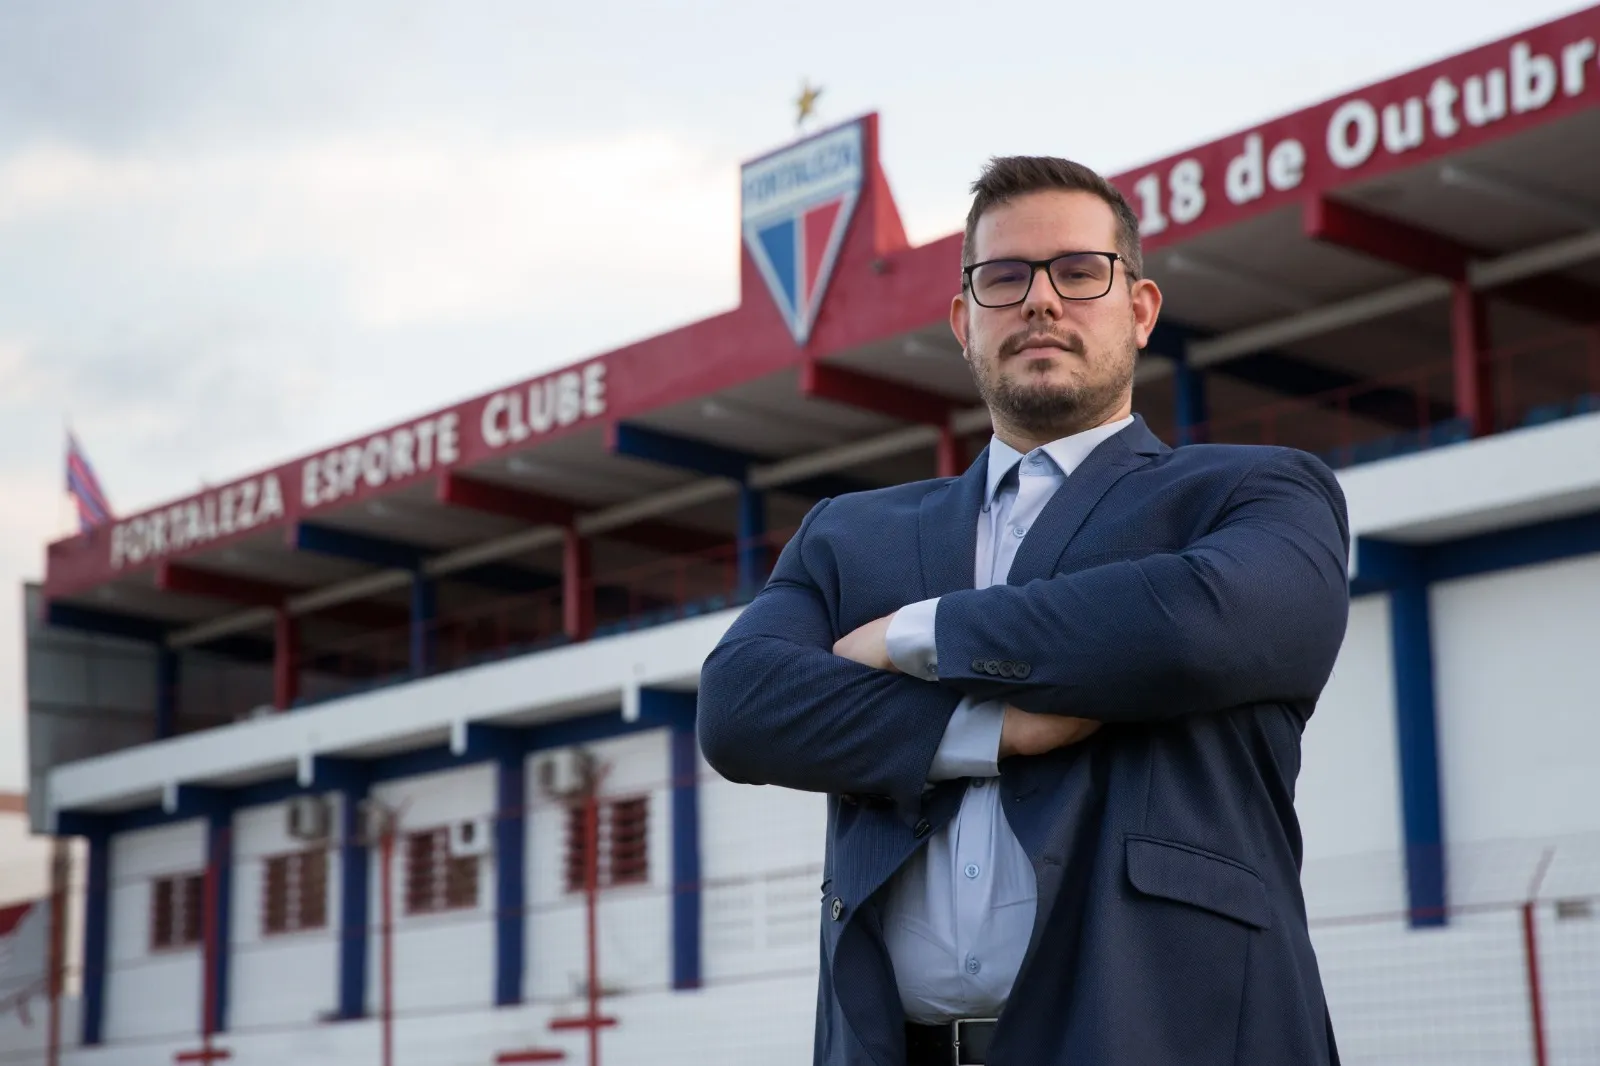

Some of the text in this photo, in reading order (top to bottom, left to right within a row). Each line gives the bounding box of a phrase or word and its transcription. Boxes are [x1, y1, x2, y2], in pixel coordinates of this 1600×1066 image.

[1134, 37, 1600, 235] 18 de Outubr
[110, 361, 607, 569] FORTALEZA ESPORTE CLUBE
